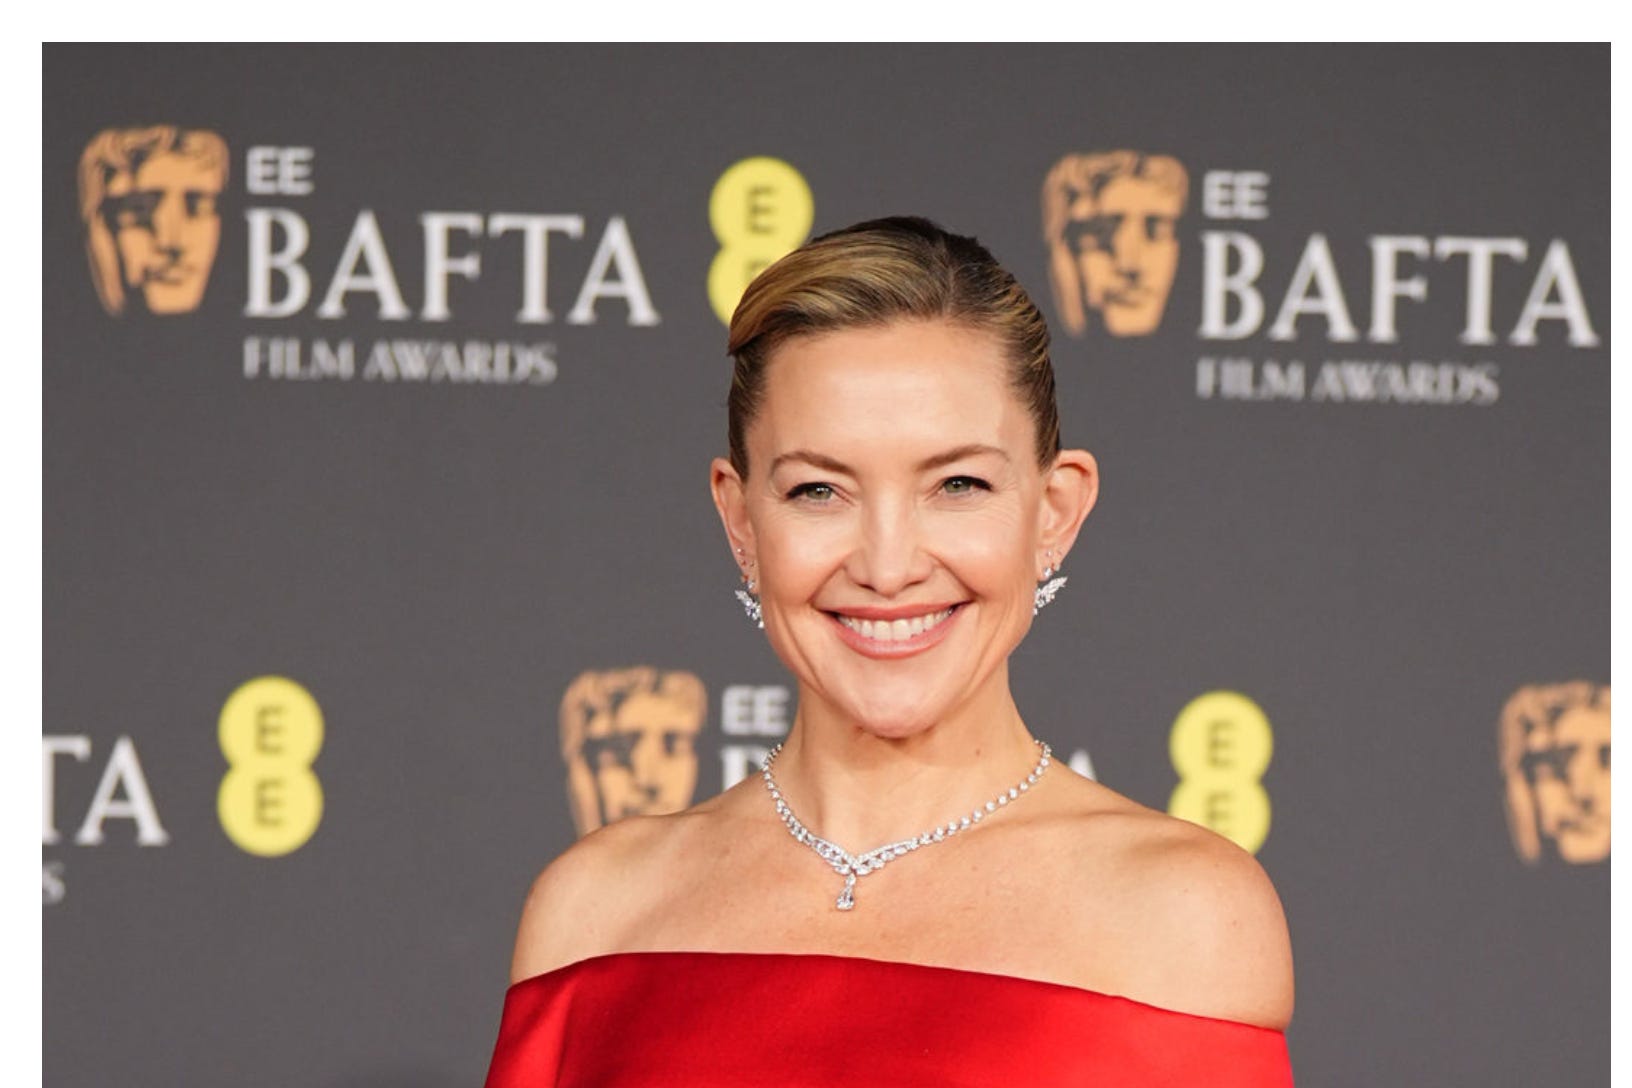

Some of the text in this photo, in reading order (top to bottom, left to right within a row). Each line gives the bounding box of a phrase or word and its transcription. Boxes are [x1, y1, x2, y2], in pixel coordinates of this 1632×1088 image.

[246, 145, 314, 196] EE
[1202, 170, 1269, 220] EE
[244, 207, 659, 326] BAFTA
[1198, 230, 1599, 347] BAFTA
[243, 336, 558, 384] FILM AWARDS
[1196, 357, 1500, 404] FILM AWARDS
[721, 685, 789, 736] EE
